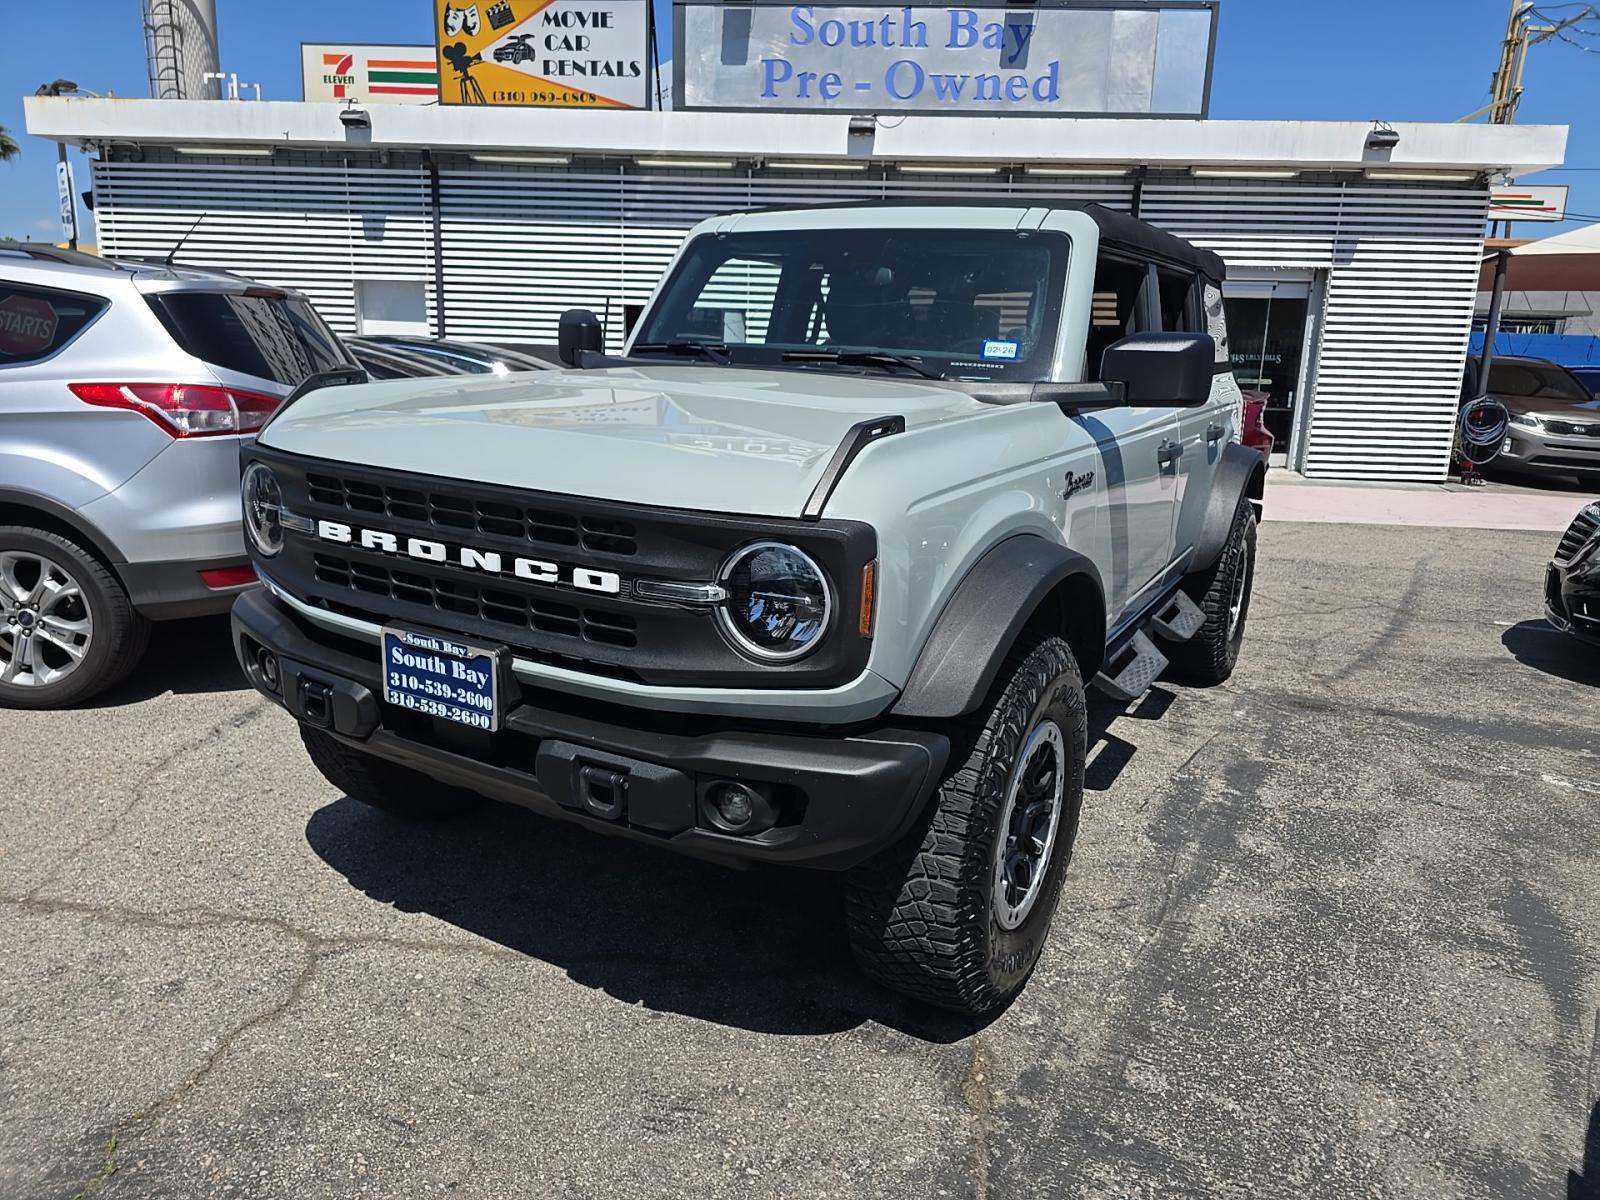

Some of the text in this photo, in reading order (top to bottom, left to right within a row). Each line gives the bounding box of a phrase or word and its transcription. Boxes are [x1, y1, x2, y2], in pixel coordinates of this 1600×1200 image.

[541, 10, 615, 29] MOVIE
[788, 5, 1037, 64] South Bay
[544, 33, 592, 52] CAR
[542, 59, 642, 77] RENTALS
[760, 58, 843, 100] Pre
[884, 60, 1060, 103] Owned
[492, 90, 526, 103] (310)
[317, 519, 621, 594] BRONCO
[406, 632, 468, 659] South Bay
[391, 645, 490, 690] South Bay
[389, 691, 491, 729] 310-539-2600
[390, 671, 494, 711] 310-539-2600
